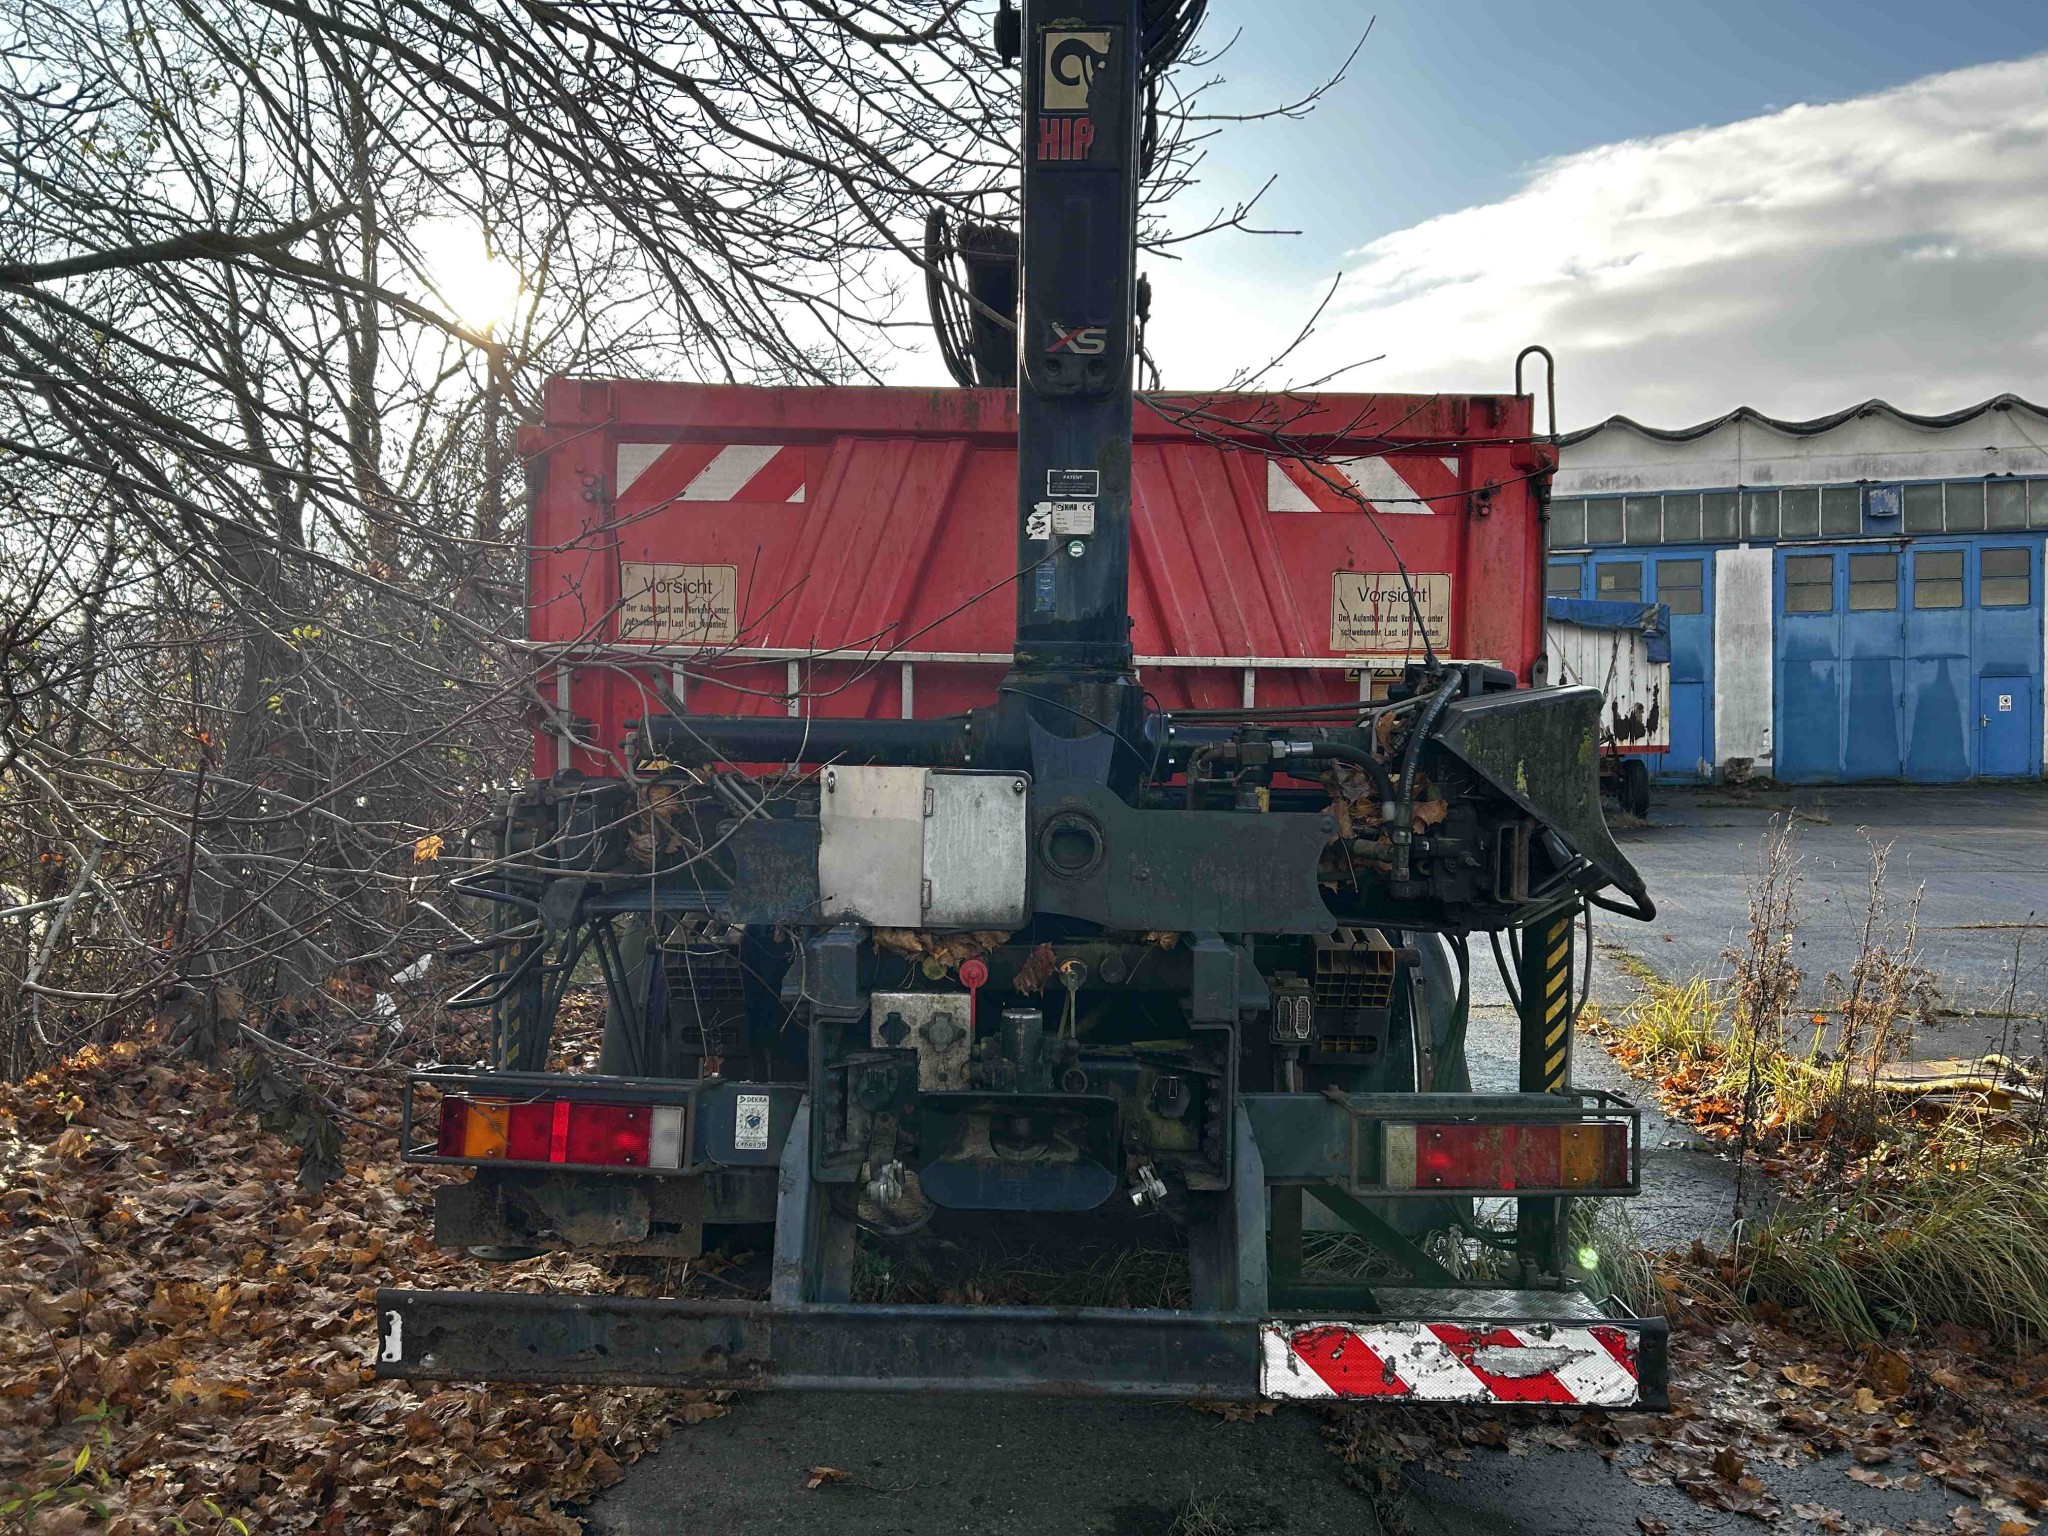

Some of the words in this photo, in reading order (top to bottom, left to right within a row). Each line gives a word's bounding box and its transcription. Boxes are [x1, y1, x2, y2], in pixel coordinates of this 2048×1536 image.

[1044, 322, 1107, 355] XS
[643, 576, 713, 595] Vorsicht
[1357, 586, 1428, 603] Vorsicht
[626, 603, 637, 613] Der
[673, 605, 684, 614] und
[714, 606, 729, 615] unter
[671, 619, 684, 628] Last
[688, 619, 696, 628] ist
[1338, 613, 1350, 623] Der
[1386, 614, 1398, 623] und
[1427, 614, 1443, 623] unter
[1384, 628, 1398, 637] Last
[1401, 628, 1409, 637] ist
